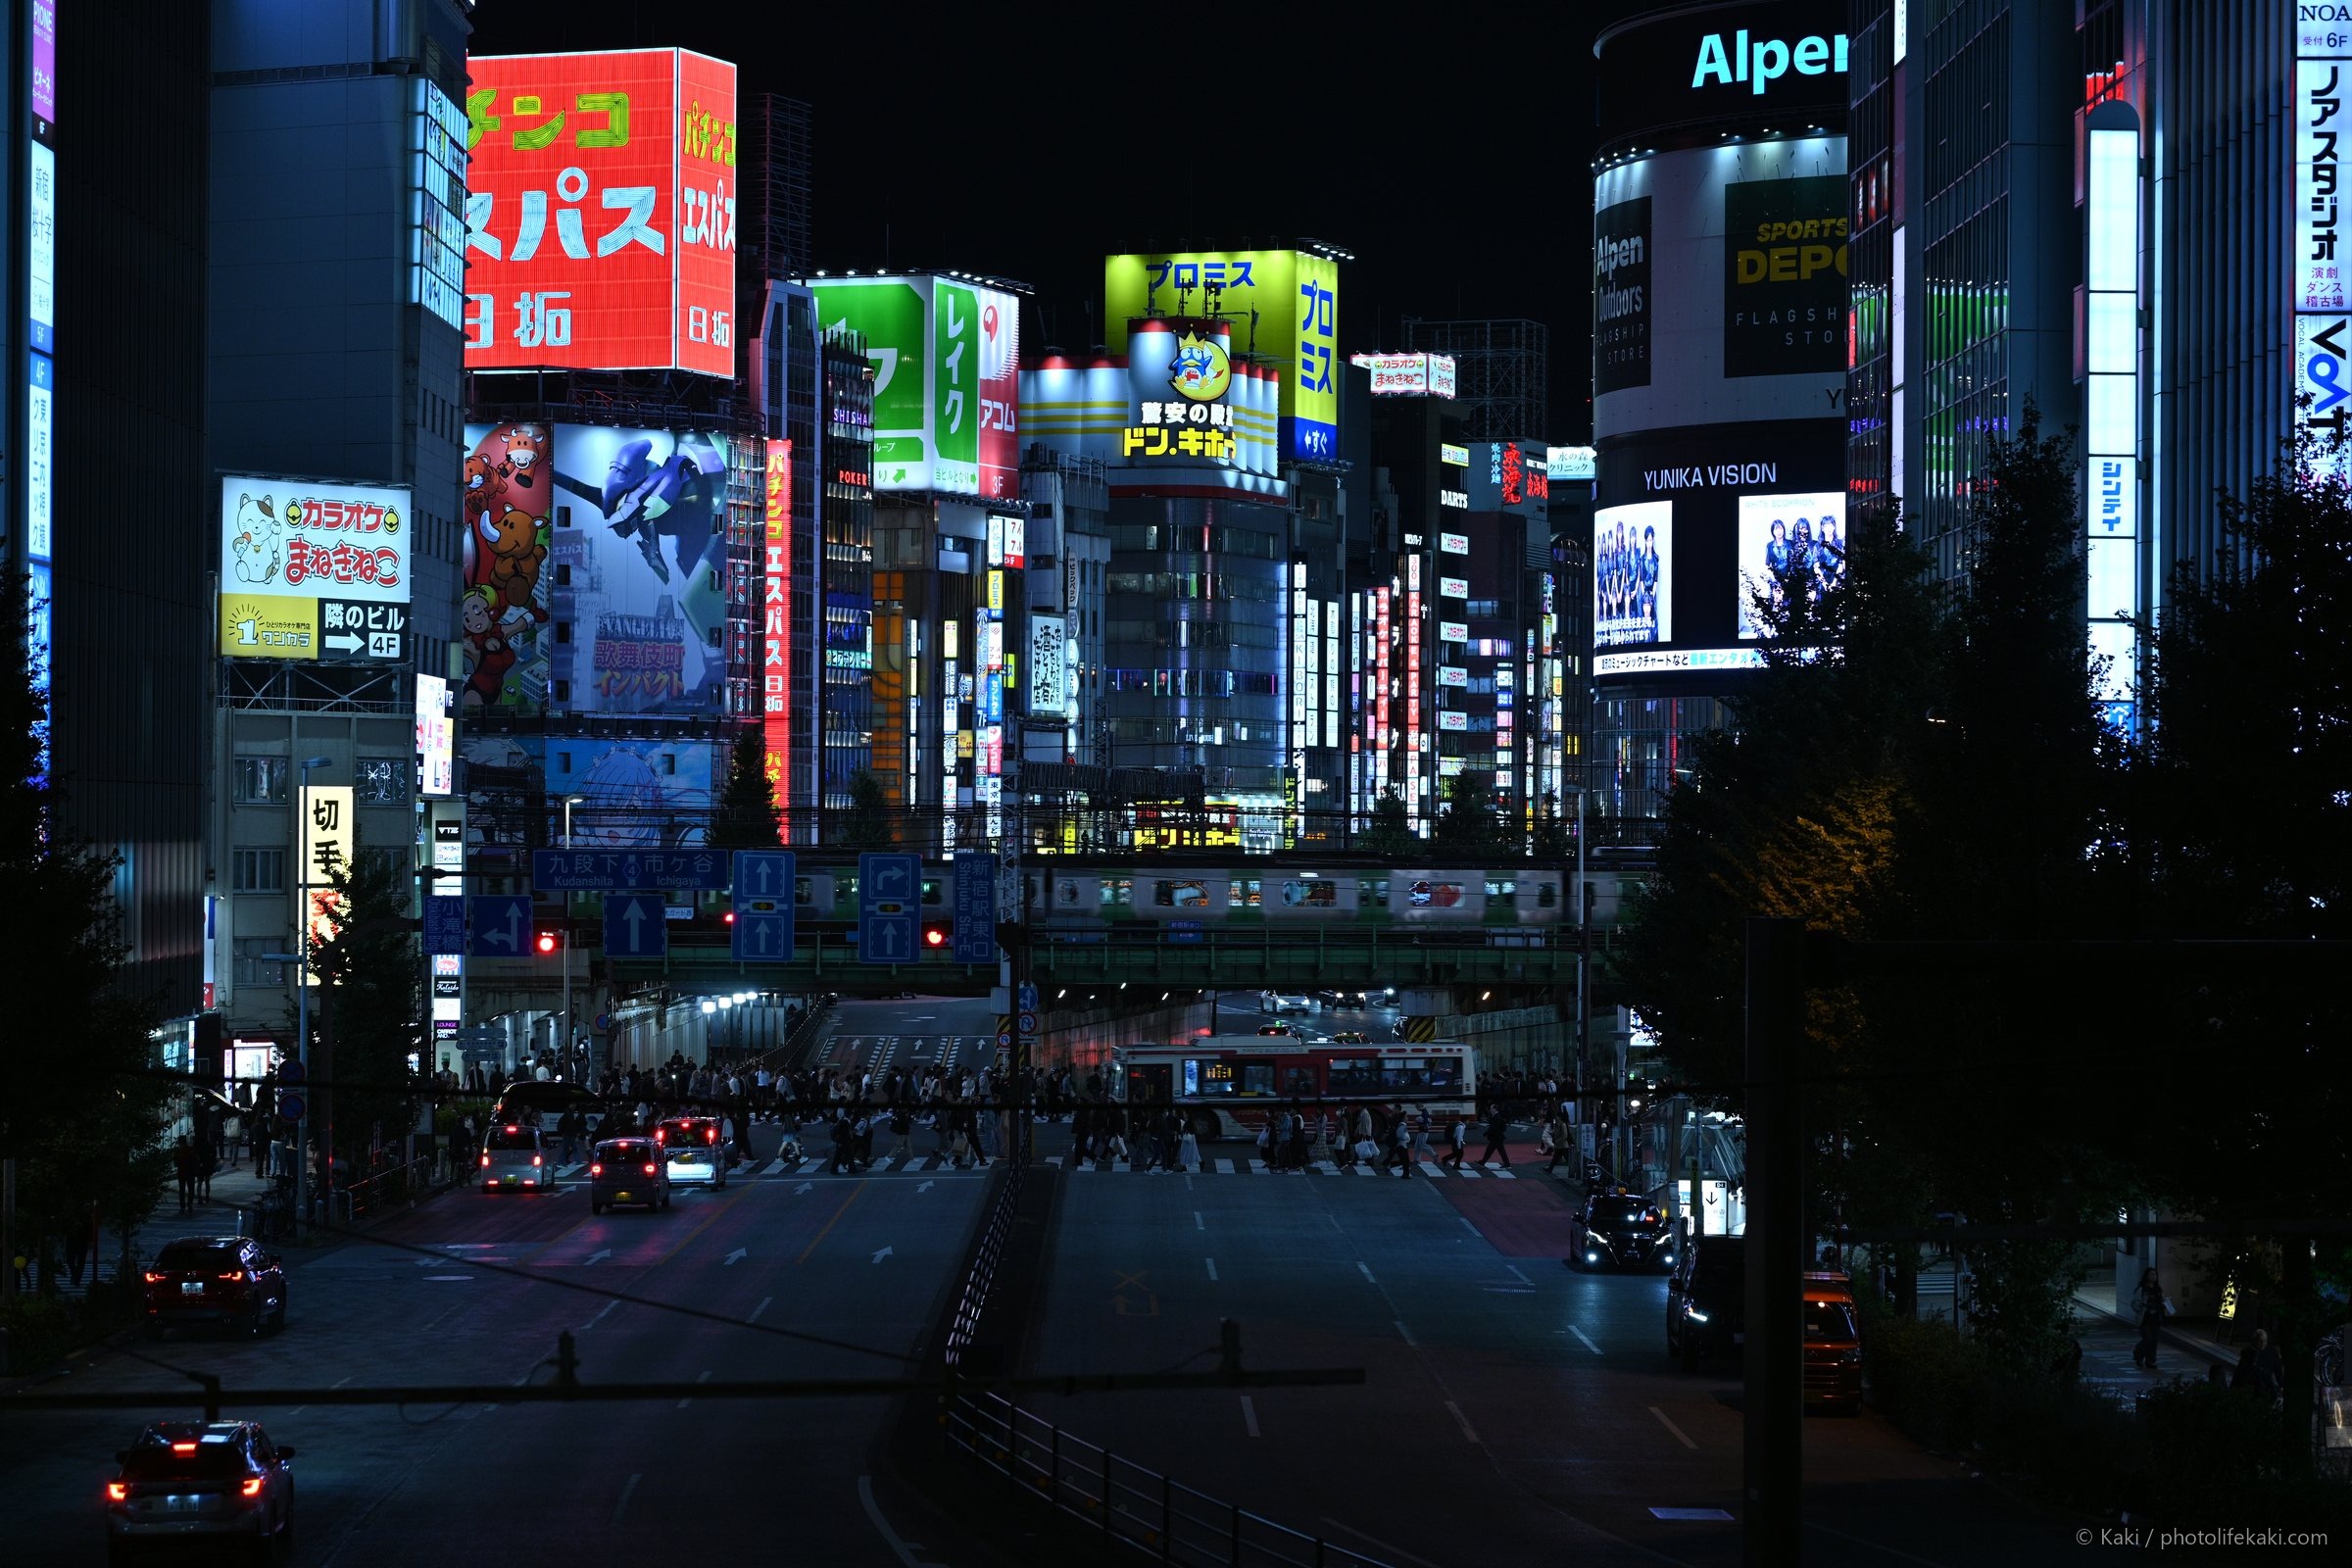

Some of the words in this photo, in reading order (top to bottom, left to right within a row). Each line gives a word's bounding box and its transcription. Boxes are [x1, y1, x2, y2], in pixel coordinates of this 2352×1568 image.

[2300, 5, 2351, 22] NOA
[2303, 36, 2323, 46] 受付
[2327, 32, 2348, 48] 6F
[683, 100, 735, 167] パチンコ
[2311, 66, 2340, 261] ノアスタジオ
[683, 178, 735, 255] エスパス
[1596, 234, 1644, 281] Alpen
[1146, 260, 1255, 289] プロミス
[2311, 266, 2338, 280] 演劇
[2306, 282, 2343, 294] ダンス
[1598, 284, 1643, 323] Outdoors
[2305, 295, 2344, 309] 稽古場
[688, 305, 730, 348] 日拓
[945, 293, 965, 435] レイク
[1382, 360, 1417, 369] カラオケ
[1607, 345, 1644, 366] STORE
[36, 360, 45, 383] 4F
[1375, 372, 1424, 387] まねきねこ
[1826, 389, 1846, 410] Y
[833, 408, 868, 426] SHISHA
[981, 398, 1016, 433] アコム
[1311, 428, 1328, 455] すぐ
[1548, 463, 1589, 473] クリニック
[1557, 451, 1589, 462] 水の森
[839, 469, 868, 487] POKER
[993, 475, 1004, 494] 3F
[1643, 466, 1704, 491] YUNIKA
[1708, 462, 1777, 487] VISION
[766, 453, 785, 540] パチンコ
[1441, 489, 1468, 509] DARTS
[301, 498, 384, 533] カラオケ
[285, 534, 401, 587] まねきねこ
[324, 603, 405, 632] 隣のビル
[765, 546, 784, 666] エスパス
[262, 631, 312, 648] ワンカラ
[597, 615, 685, 639] EVANGELION
[371, 637, 398, 655] 4F
[595, 641, 686, 671] 歌舞伎町
[593, 669, 686, 699] インパクト
[764, 675, 783, 712] 日拓
[976, 710, 988, 727] 7F
[313, 799, 342, 874] 切手
[549, 854, 619, 874] 九段下
[554, 875, 614, 887] Kudanshita
[657, 875, 702, 888] Ichigaya
[958, 861, 971, 912] Shinjuku
[972, 858, 989, 957] 新宿駅東口
[442, 899, 462, 952] 小滝橋
